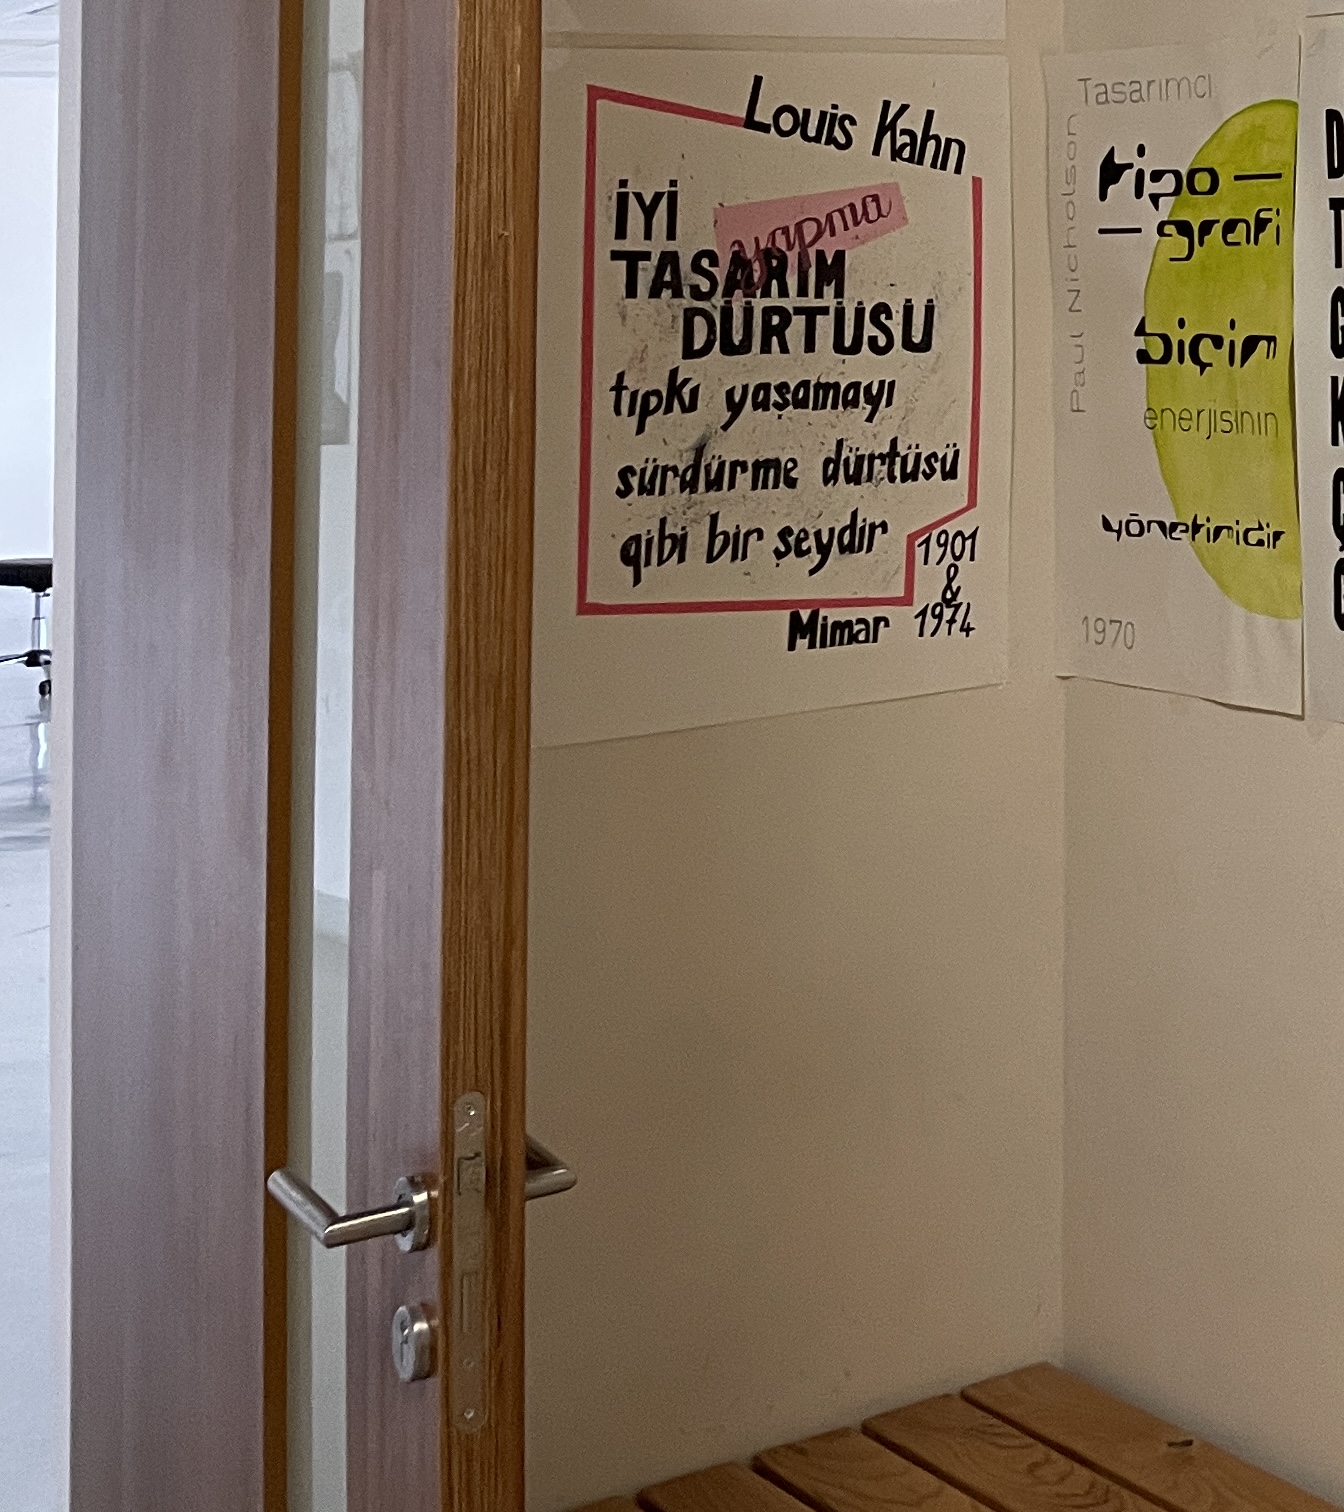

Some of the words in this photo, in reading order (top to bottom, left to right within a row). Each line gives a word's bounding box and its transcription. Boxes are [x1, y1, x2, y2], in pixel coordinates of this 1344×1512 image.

[1077, 73, 1213, 107] Tasarımcı
[742, 75, 858, 152] Louis
[871, 99, 967, 176] Kahn
[613, 178, 679, 242] İYİ
[1060, 112, 1083, 314] Nicholson
[610, 248, 847, 302] TASARIM
[730, 192, 893, 296] yapma
[681, 298, 936, 361] DÜRTÜSÜ
[609, 366, 702, 436] tıpkı
[719, 377, 897, 432] yaşamayı
[1068, 331, 1087, 414] Paul
[615, 442, 799, 500] sürdürme
[821, 436, 960, 488] dürtüsü
[704, 510, 764, 565] bir
[772, 506, 889, 577] şeydir
[916, 525, 980, 567] 1901
[786, 607, 892, 653] Mimar
[912, 600, 976, 639] 1974
[1081, 615, 1136, 651] 1970
